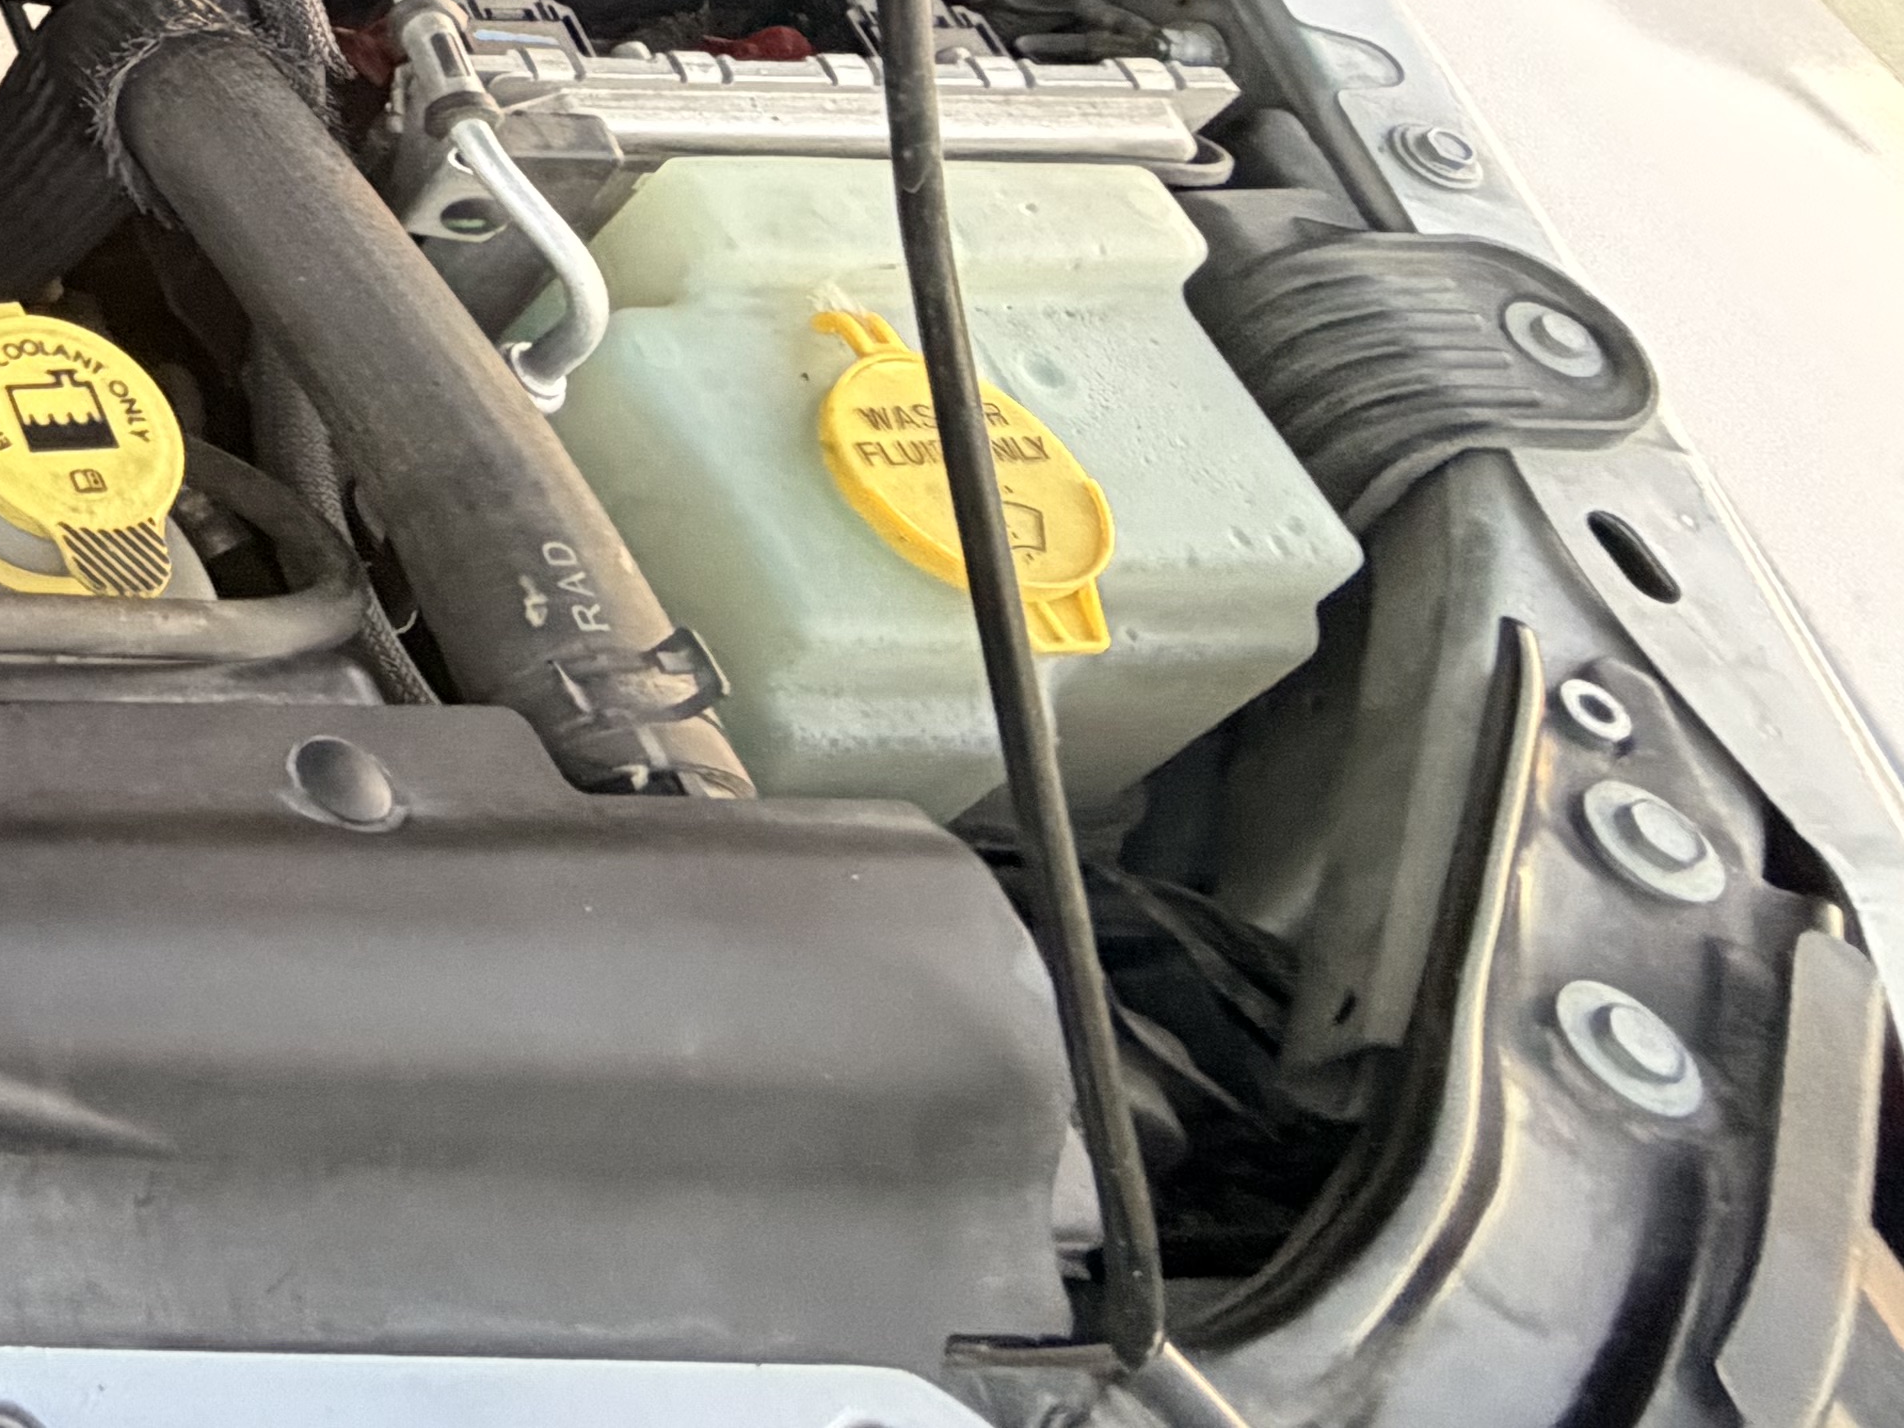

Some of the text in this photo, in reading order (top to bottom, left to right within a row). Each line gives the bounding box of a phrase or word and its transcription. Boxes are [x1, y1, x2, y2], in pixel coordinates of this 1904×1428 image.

[108, 379, 151, 443] ONLY
[852, 401, 1010, 432] WASR
[542, 539, 611, 634] RAD
